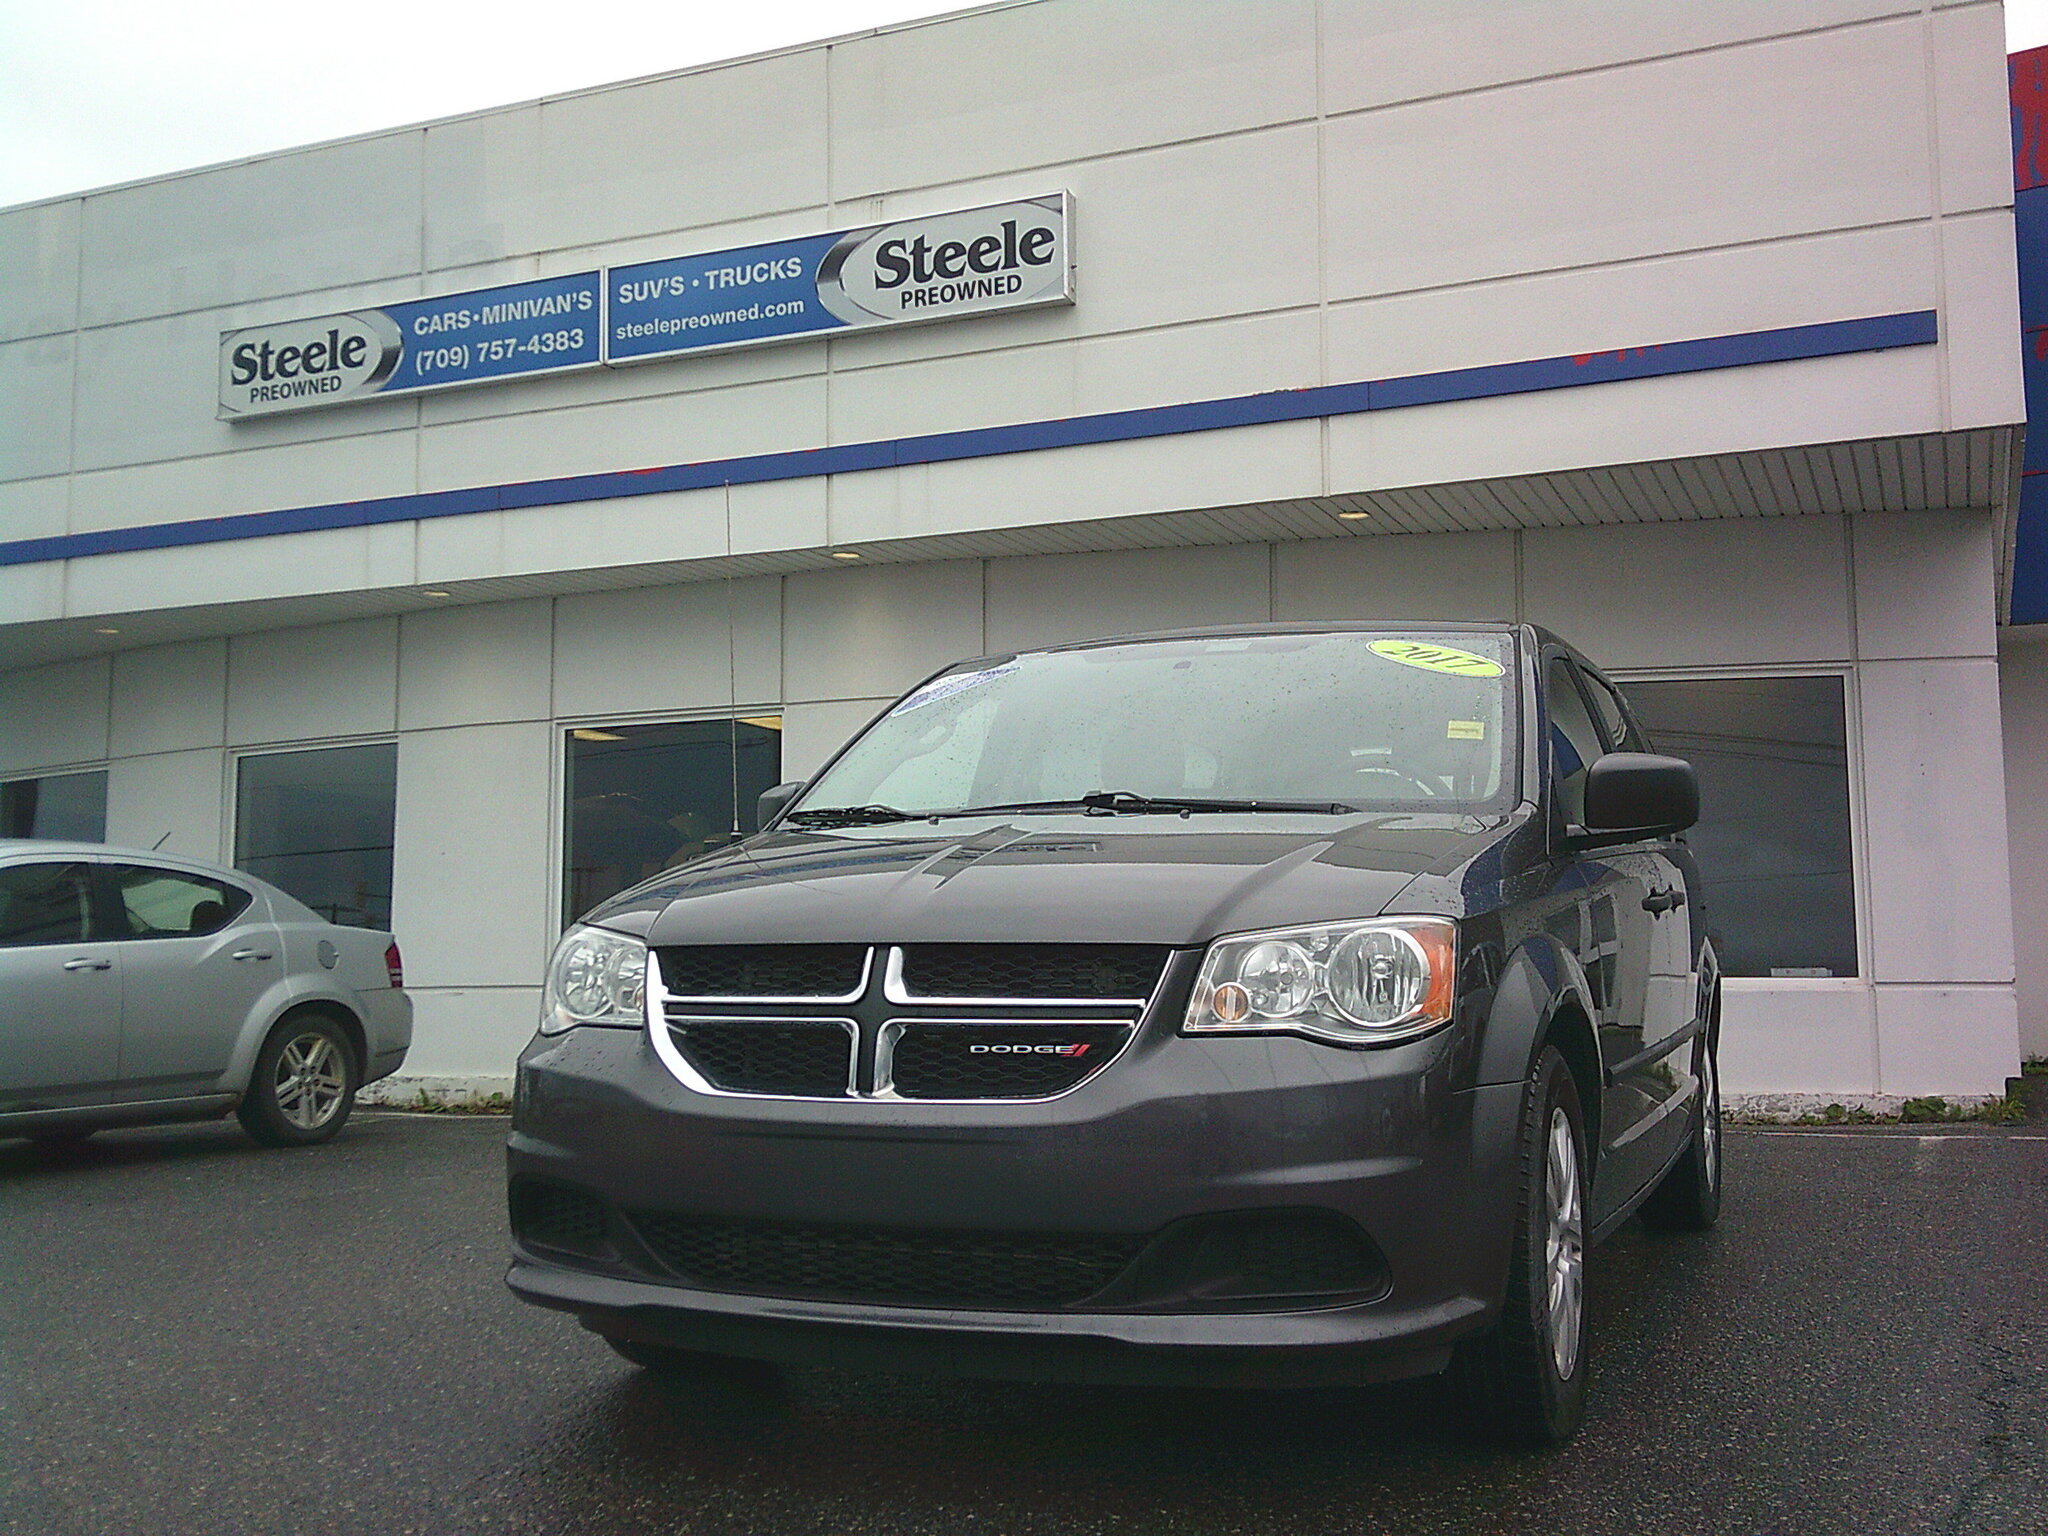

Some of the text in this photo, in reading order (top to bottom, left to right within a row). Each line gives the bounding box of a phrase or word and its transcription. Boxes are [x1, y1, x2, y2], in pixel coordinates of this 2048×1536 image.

[873, 219, 1055, 290] Steele
[618, 256, 802, 305] SUV'S TRUCKS
[900, 274, 1023, 309] PREOWNED
[615, 298, 805, 340] steelepreowned.com
[230, 328, 368, 387] Steele
[415, 328, 584, 376] (709) 757-4383
[249, 374, 342, 404] PREOWNED
[1381, 645, 1489, 669] 2017
[969, 1044, 1076, 1054] DODGE
